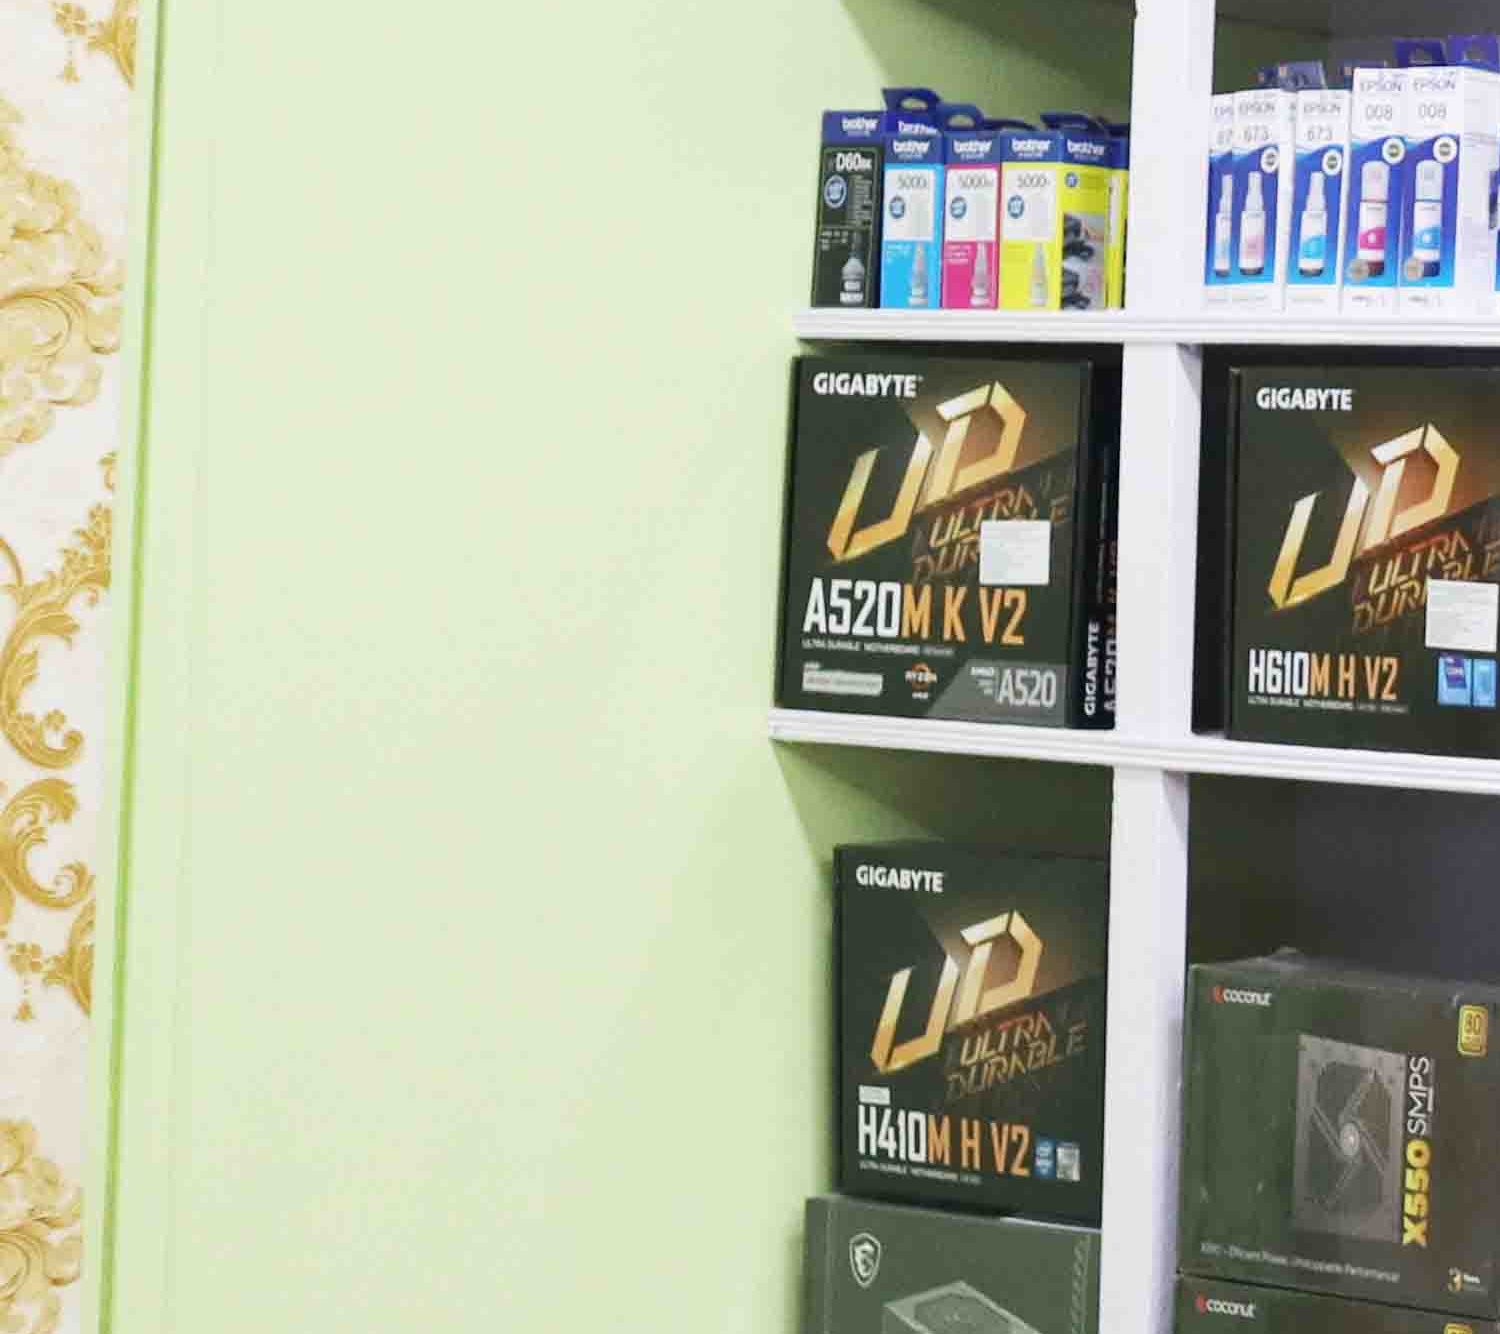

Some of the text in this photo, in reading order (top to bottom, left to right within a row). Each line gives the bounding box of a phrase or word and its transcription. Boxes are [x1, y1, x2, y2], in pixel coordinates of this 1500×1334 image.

[814, 373, 916, 398] GIGABYTE
[1257, 387, 1353, 411] GIGABYTE
[803, 577, 1026, 645] A520M K V2
[997, 669, 1056, 707] A520
[1249, 649, 1400, 701] H610M H V2
[856, 865, 944, 893] GIGABYTE
[857, 1104, 951, 1166] H410M
[961, 1118, 981, 1171] H
[991, 1121, 1031, 1177] V2
[1402, 1055, 1434, 1248] X550 SMPS
